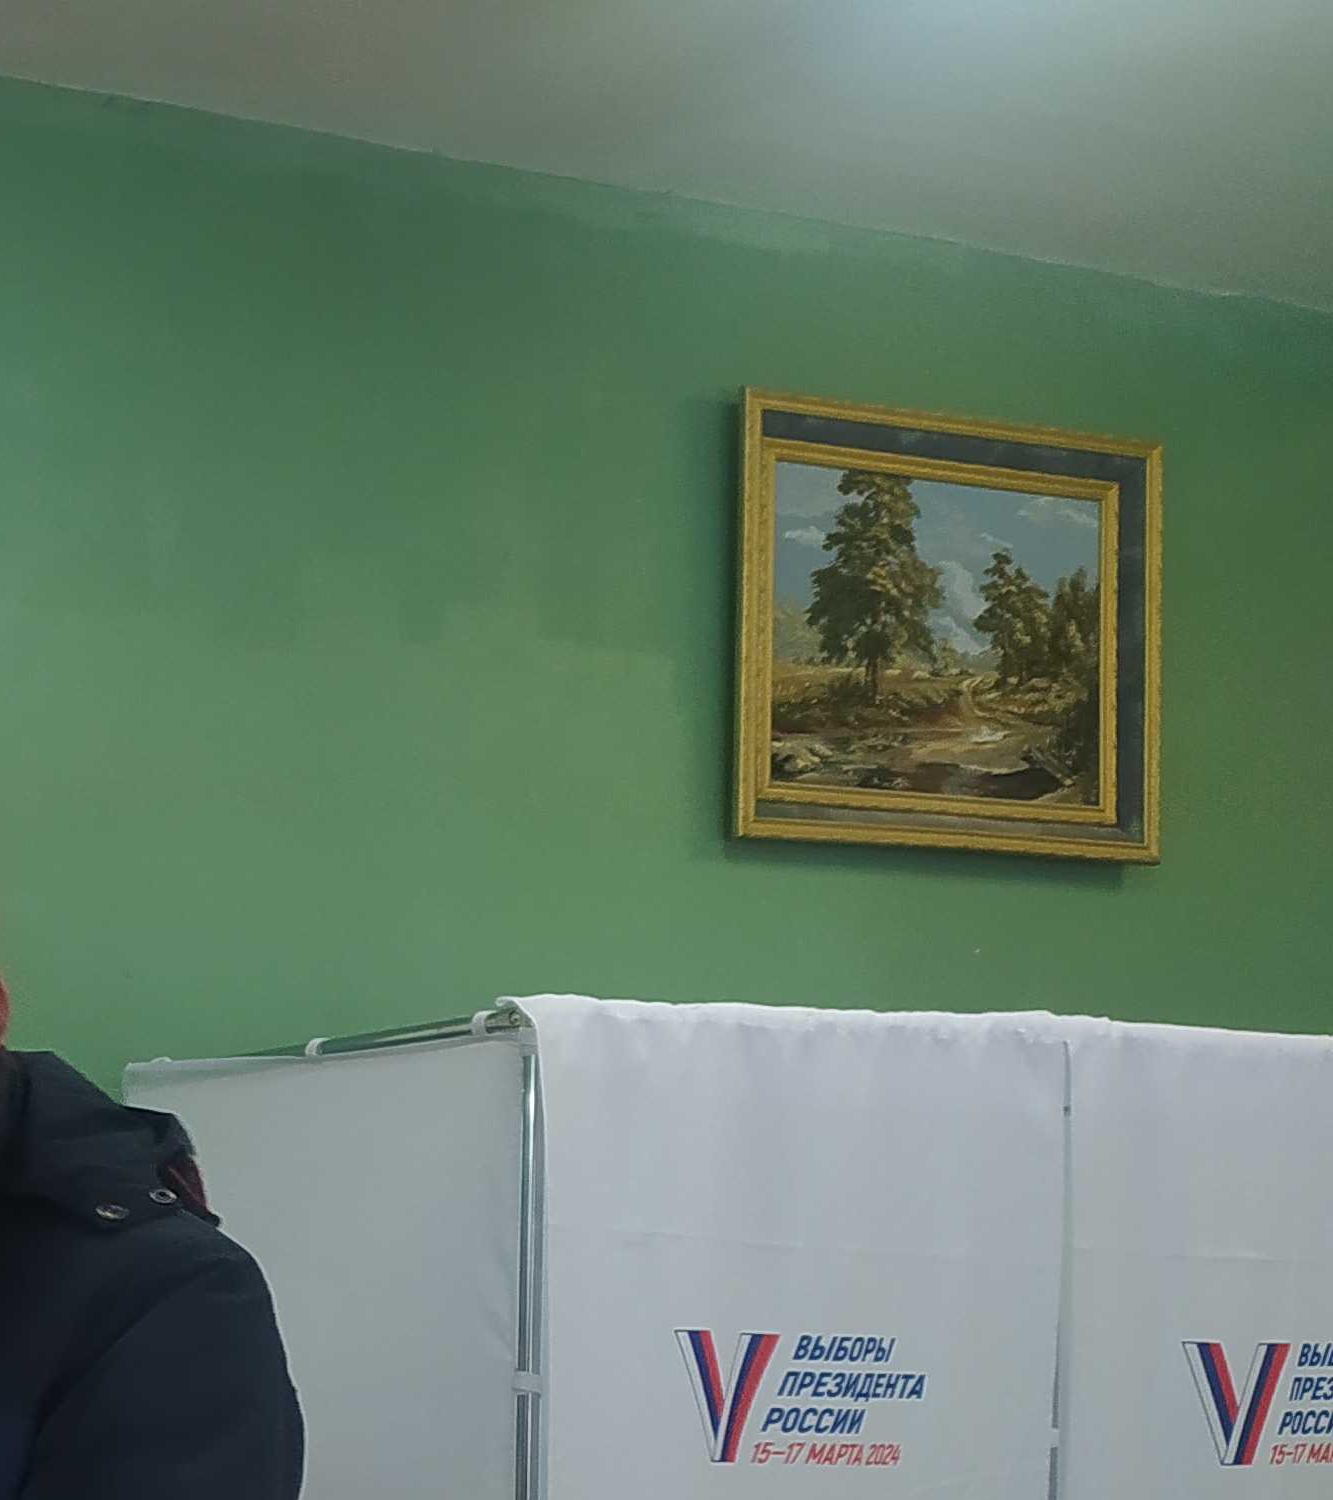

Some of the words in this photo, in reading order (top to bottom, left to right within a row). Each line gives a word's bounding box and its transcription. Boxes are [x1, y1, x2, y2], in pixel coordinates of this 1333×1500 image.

[792, 1334, 896, 1363] ВЫБОРЫ
[777, 1370, 927, 1402] ПРЕЗИДЕНТА
[760, 1406, 867, 1435] РОССИИ
[804, 1442, 863, 1466] МАРТА
[864, 1443, 901, 1466] 2024
